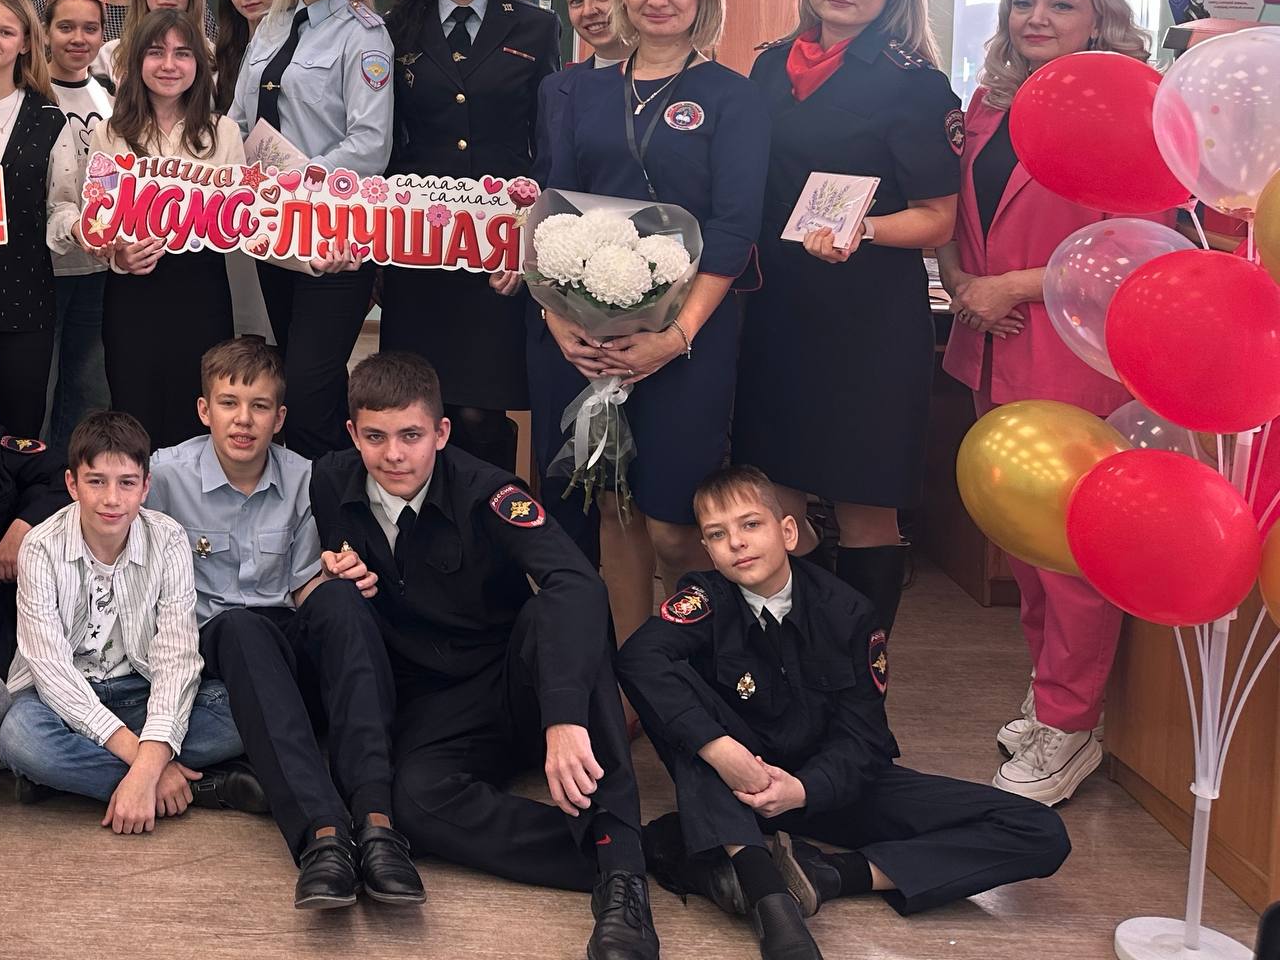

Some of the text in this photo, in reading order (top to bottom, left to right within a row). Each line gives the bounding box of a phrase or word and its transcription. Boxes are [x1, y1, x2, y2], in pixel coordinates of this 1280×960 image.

[138, 157, 235, 188] наша
[396, 177, 473, 191] самая
[491, 486, 514, 507] РОССИЯ
